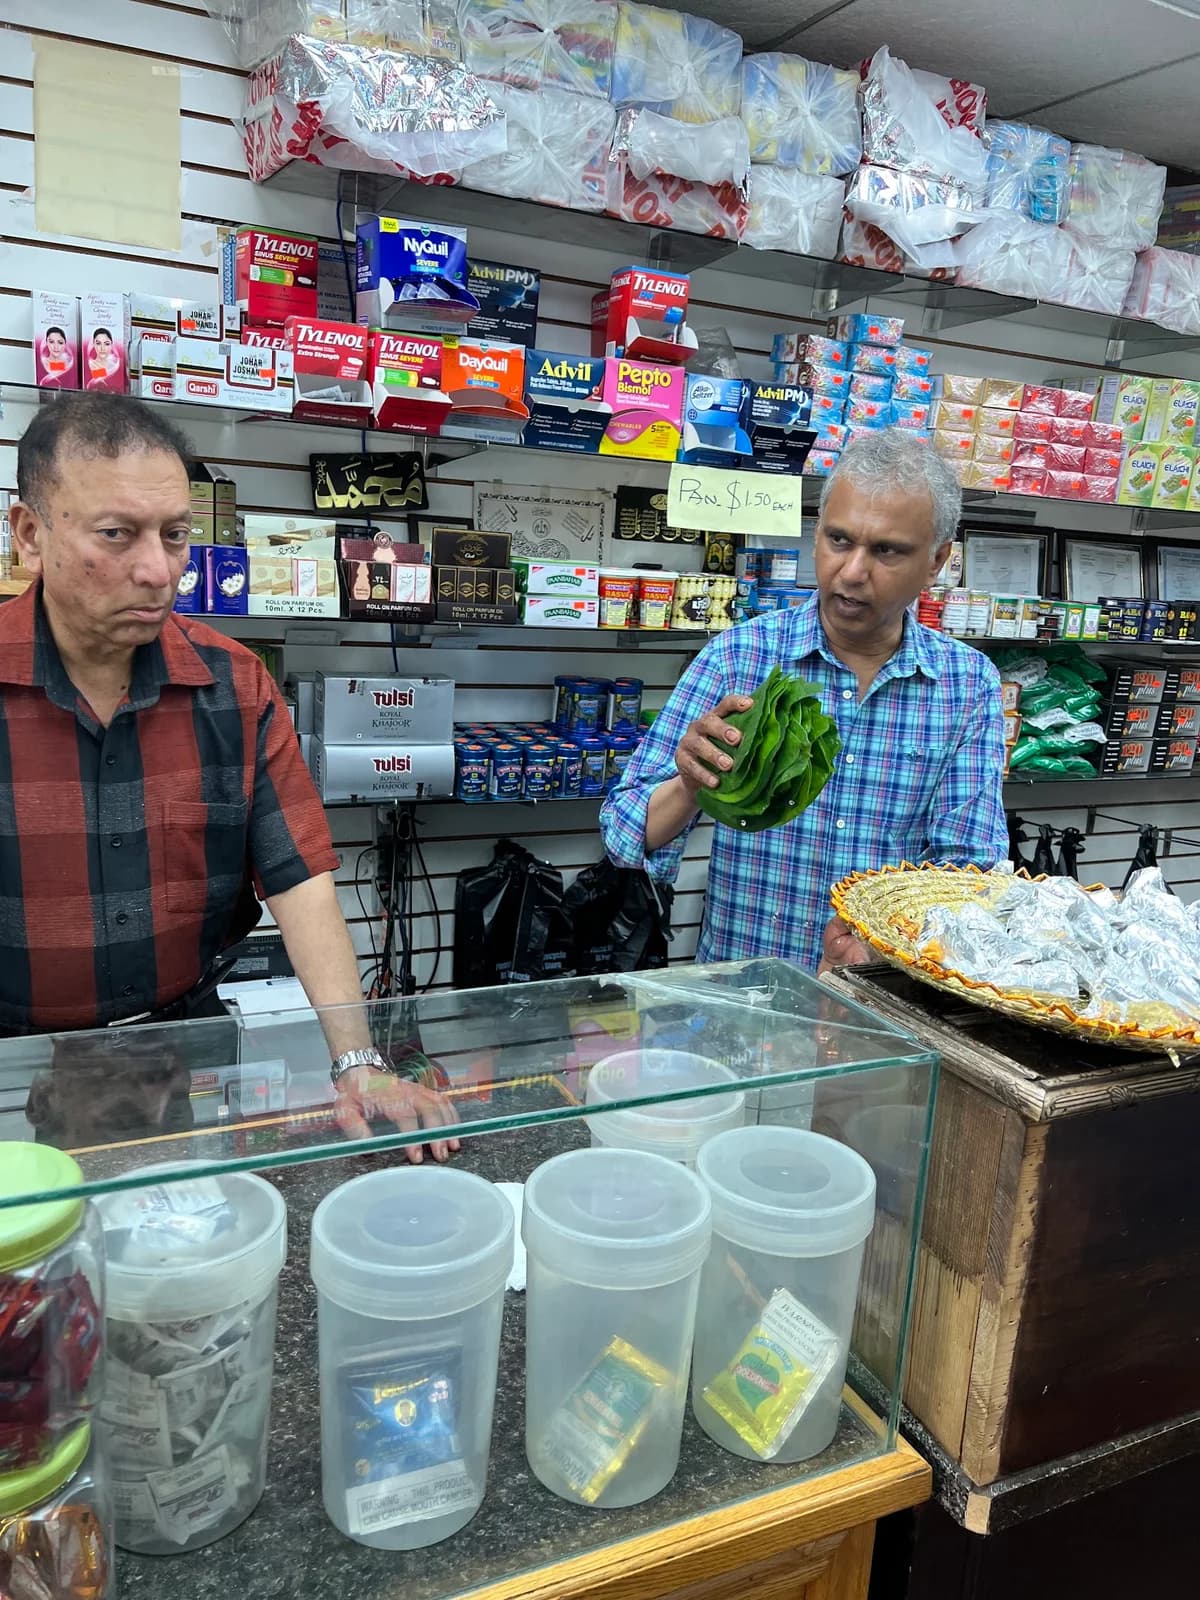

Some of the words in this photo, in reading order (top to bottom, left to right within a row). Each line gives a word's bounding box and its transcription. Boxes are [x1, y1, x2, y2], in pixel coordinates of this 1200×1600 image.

[254, 233, 314, 259] TYLENOL
[404, 237, 448, 258] NyQuil
[470, 265, 503, 281] Advil
[505, 269, 528, 284] PM
[634, 274, 686, 297] TYLENOL
[190, 311, 211, 321] JOHAR
[297, 325, 364, 349] TYLENOL
[380, 335, 440, 359] TYLENOL
[240, 356, 263, 368] JOHAR
[459, 352, 508, 374] DayQuil
[537, 358, 591, 382] Advil
[619, 361, 671, 387] Pepto
[189, 383, 217, 394] Qarshi
[618, 383, 652, 396] Bismol
[755, 386, 784, 401] Advil
[785, 388, 804, 403] PM
[1122, 395, 1147, 405] ELAICHI
[1132, 460, 1156, 470] ELAICHI
[1164, 464, 1190, 474] ELAICHI
[1135, 683, 1155, 699] plus
[372, 719, 411, 729] KHAJOOR
[1121, 743, 1145, 757] 120
[372, 782, 409, 791] KHAJOOR
[779, 1301, 825, 1339] WARNING
[358, 1491, 401, 1514] WARNING
[410, 1483, 431, 1499] THIS
